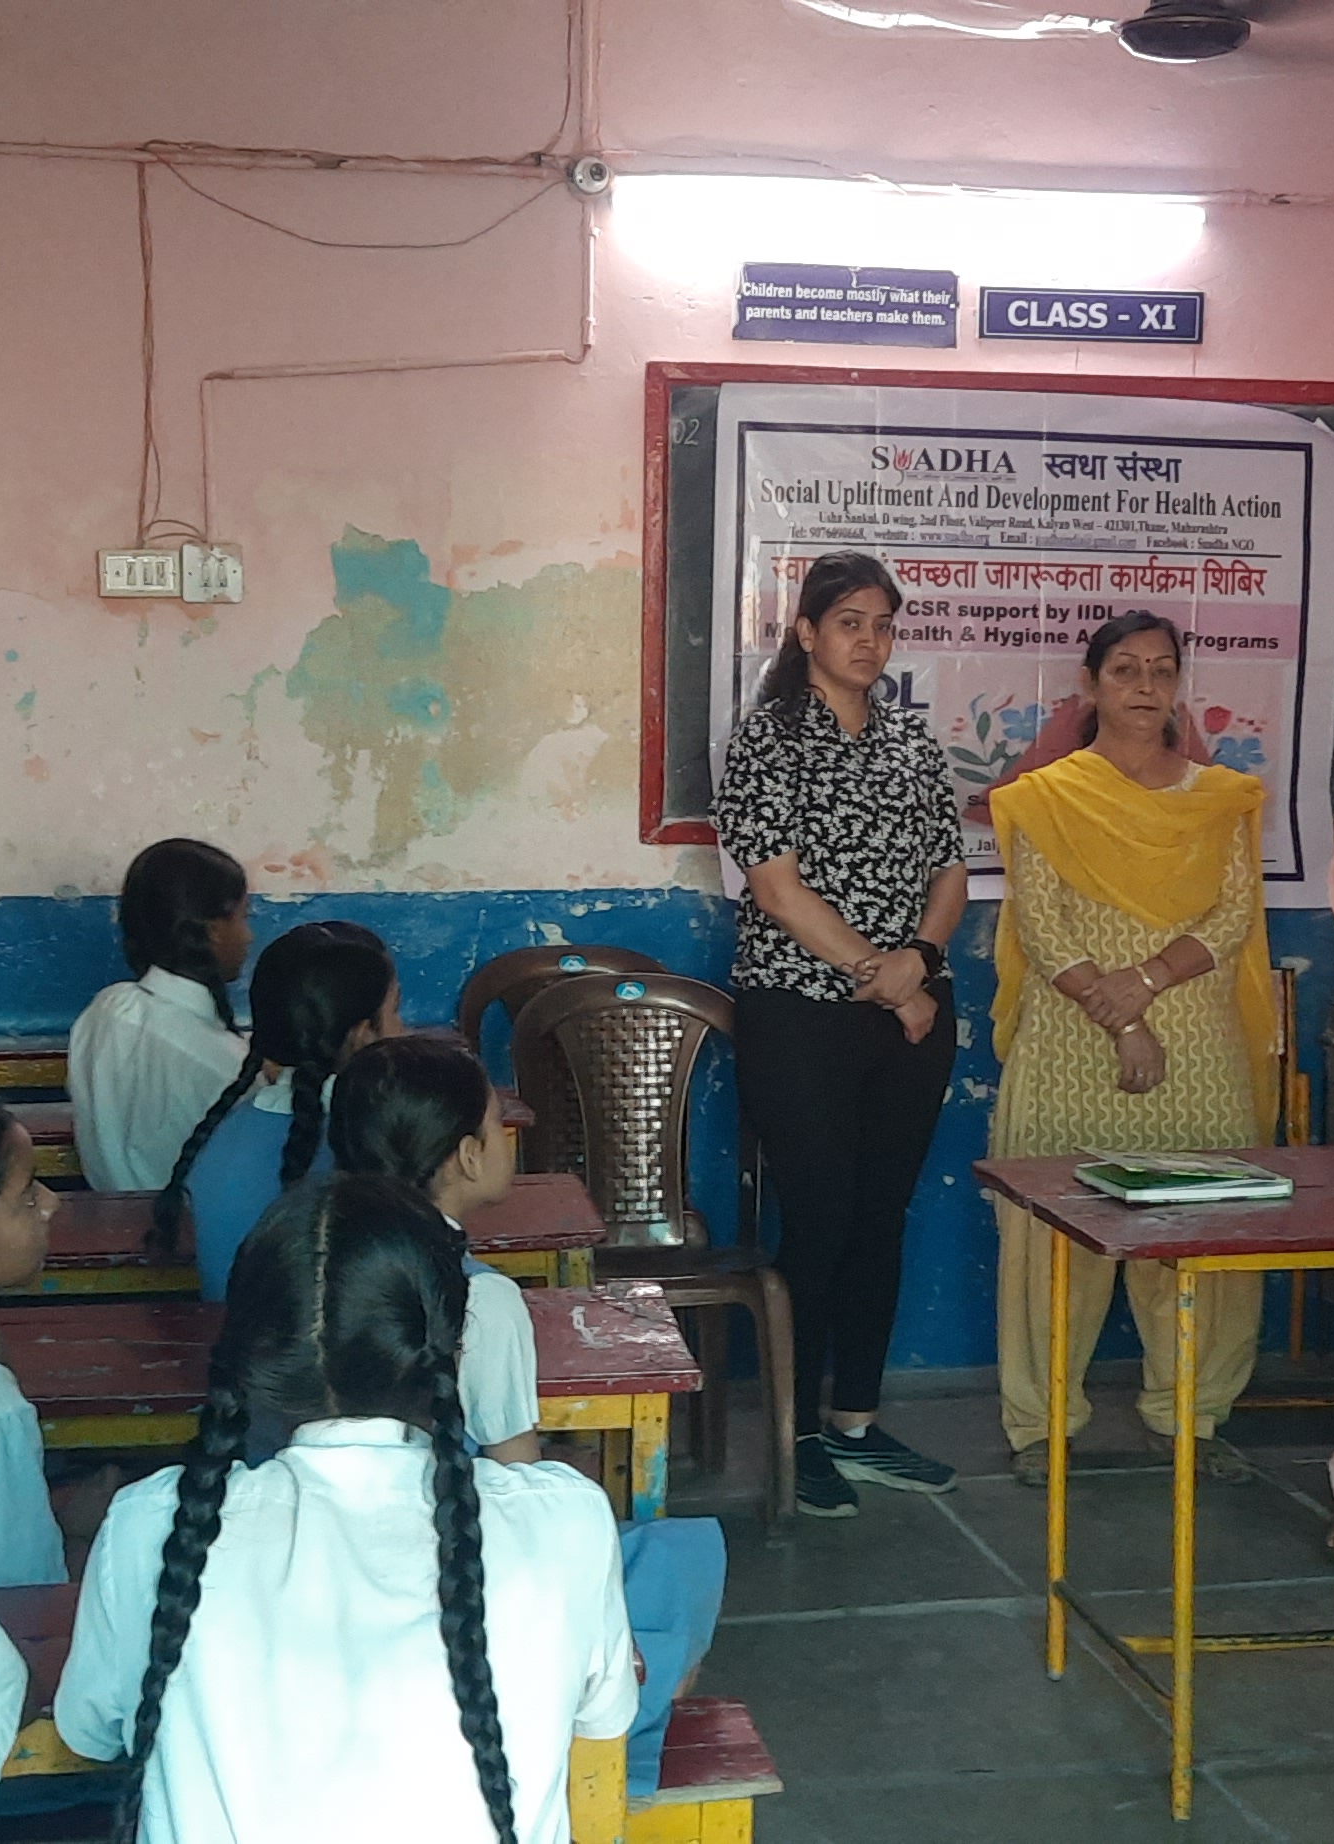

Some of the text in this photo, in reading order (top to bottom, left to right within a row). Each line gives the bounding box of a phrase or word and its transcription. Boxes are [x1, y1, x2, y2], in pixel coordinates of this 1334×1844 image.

[742, 282, 793, 298] Children
[795, 283, 843, 300] become
[846, 287, 887, 305] mostly
[889, 290, 919, 303] what
[745, 305, 947, 325] parents and teachers make them.
[1007, 300, 1108, 329] CLASS
[1139, 303, 1178, 330] XI
[1042, 451, 1182, 484] स्वधा संस्था
[761, 478, 1282, 519] Social Upliftment And Development For Health Action
[882, 512, 890, 525] D
[893, 558, 978, 589] स्वच्छता
[983, 561, 1103, 592] जागरूकता
[1108, 555, 1197, 596] कार्यक्रम
[905, 600, 951, 617] CSR
[957, 604, 1039, 622] support
[1045, 603, 1070, 624] by
[1077, 603, 1120, 620] IIDL
[960, 625, 976, 642] &
[984, 626, 1069, 647] Hygiene
[1182, 631, 1279, 651] Programs
